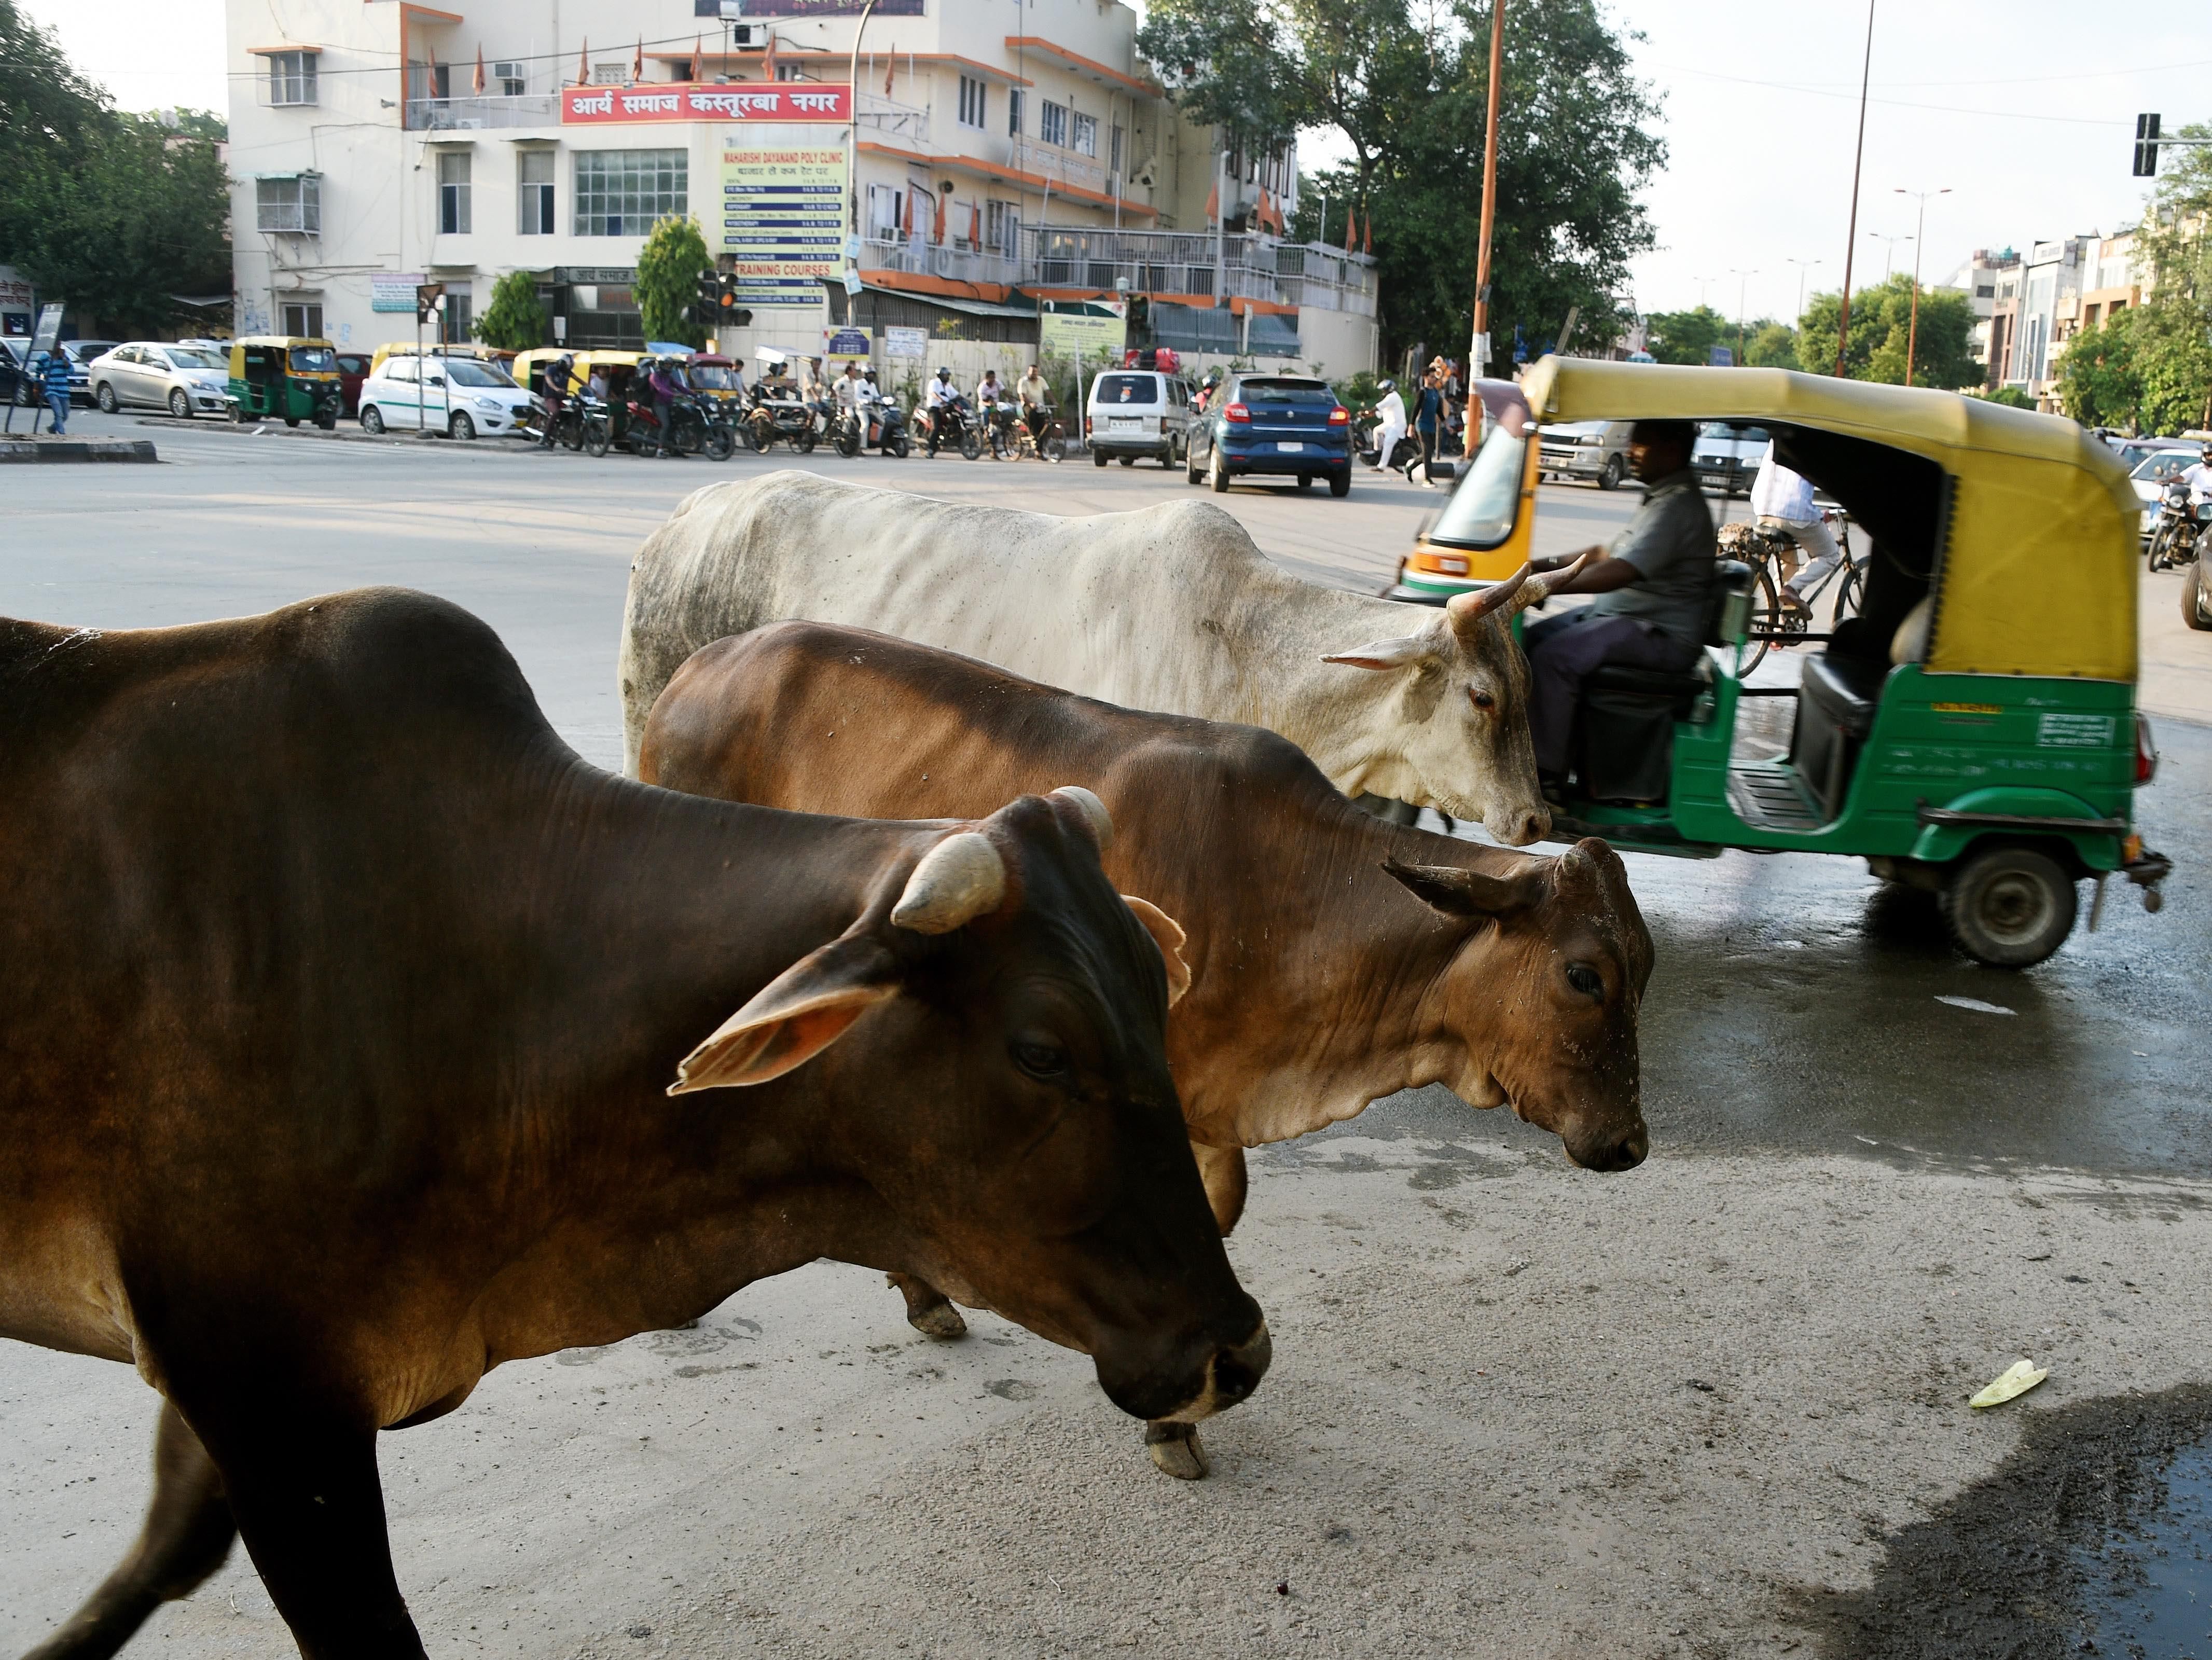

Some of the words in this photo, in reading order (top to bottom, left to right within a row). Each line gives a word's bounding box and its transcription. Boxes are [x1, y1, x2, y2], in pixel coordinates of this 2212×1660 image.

[572, 90, 614, 116] आर्य
[621, 93, 680, 114] समाज
[687, 92, 780, 118] कस्तूरबा
[789, 92, 840, 113] नगर
[801, 152, 818, 164] POLY
[821, 152, 843, 164] CLINIC
[734, 264, 780, 275] TRAINING
[784, 264, 831, 276] COURSES
